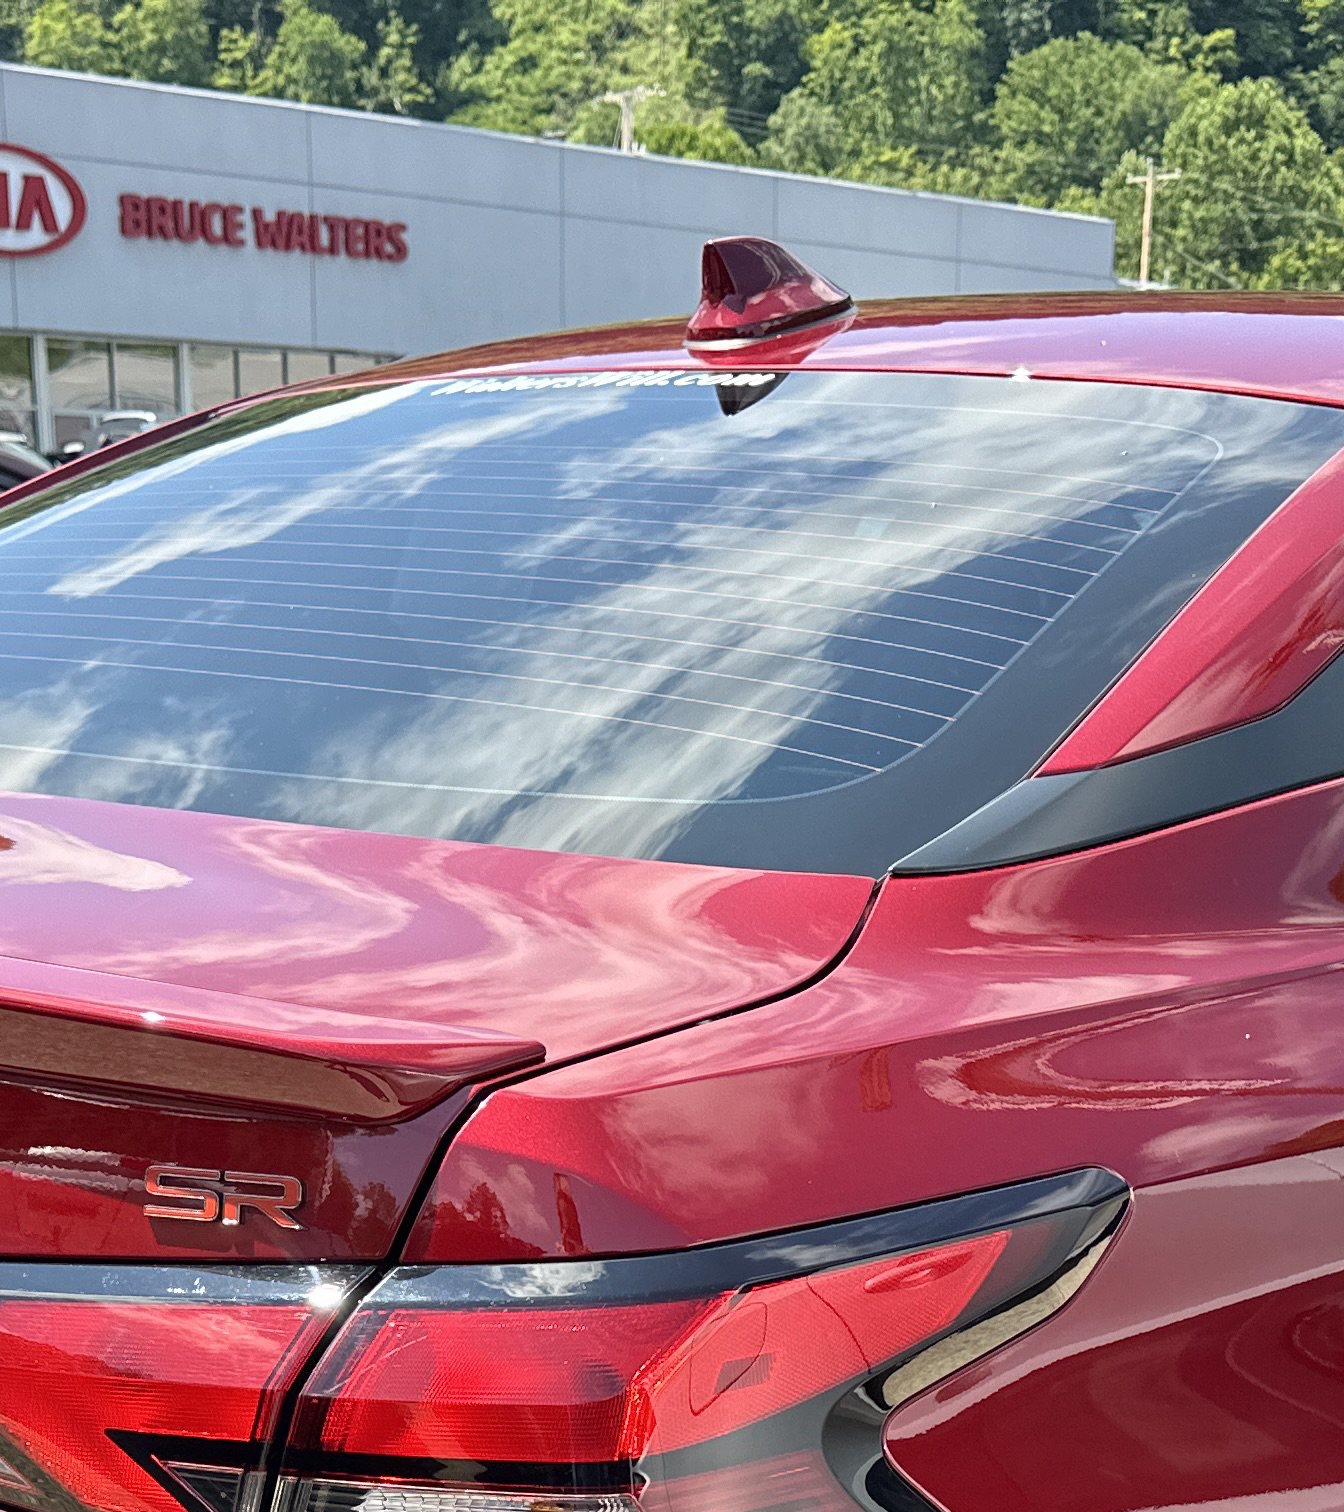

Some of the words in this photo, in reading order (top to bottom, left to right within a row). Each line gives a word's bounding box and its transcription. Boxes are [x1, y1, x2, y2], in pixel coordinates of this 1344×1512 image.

[119, 193, 246, 246] BRUCE
[253, 208, 408, 263] WALTERS
[143, 1165, 307, 1229] SR
